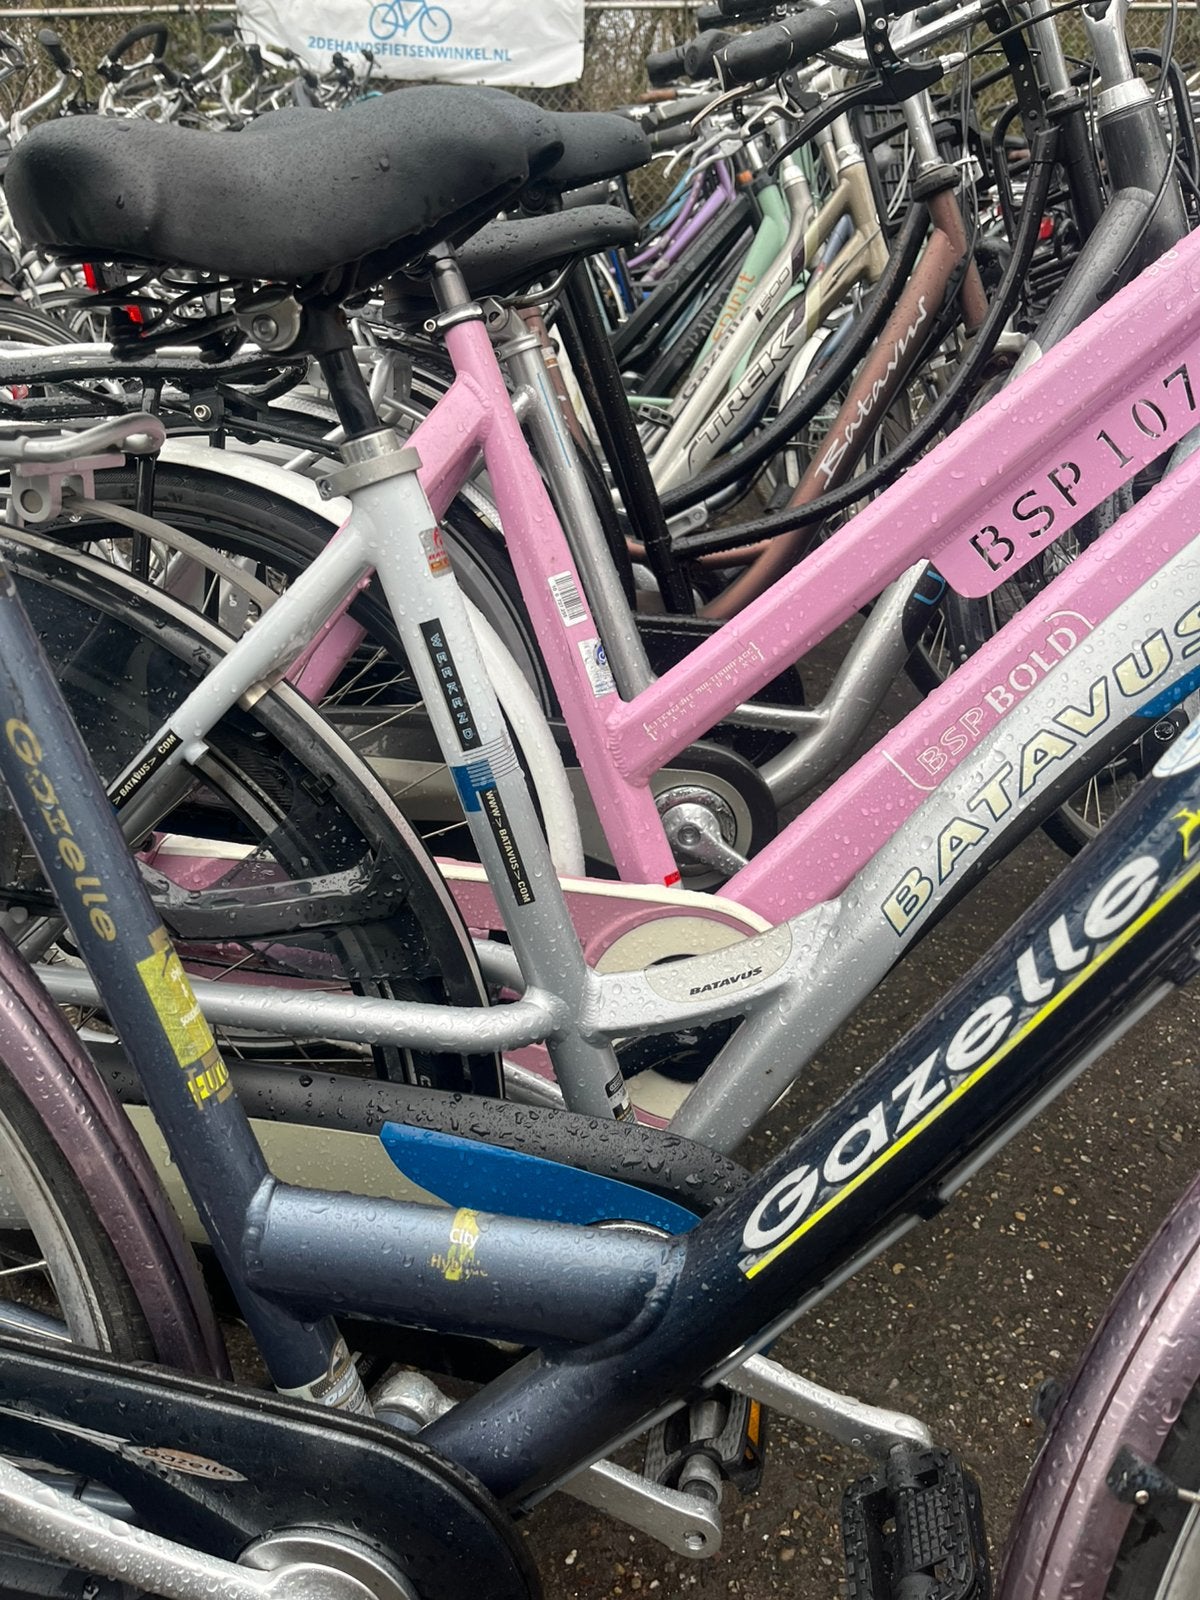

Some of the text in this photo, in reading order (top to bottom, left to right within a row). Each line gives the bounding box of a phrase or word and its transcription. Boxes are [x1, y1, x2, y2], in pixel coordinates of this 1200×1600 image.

[308, 36, 512, 61] 2DEHANDSFIETSENWINKEL.NL
[681, 287, 730, 358] SPART
[697, 308, 797, 444] TREK
[969, 364, 1197, 571] BSP 107
[430, 632, 474, 739] WEEKEND
[916, 627, 1077, 776] BSP BOLD
[689, 966, 763, 995] BATAVUS
[742, 856, 1161, 1250] Gazelle
[141, 1447, 233, 1476] Gazelle
